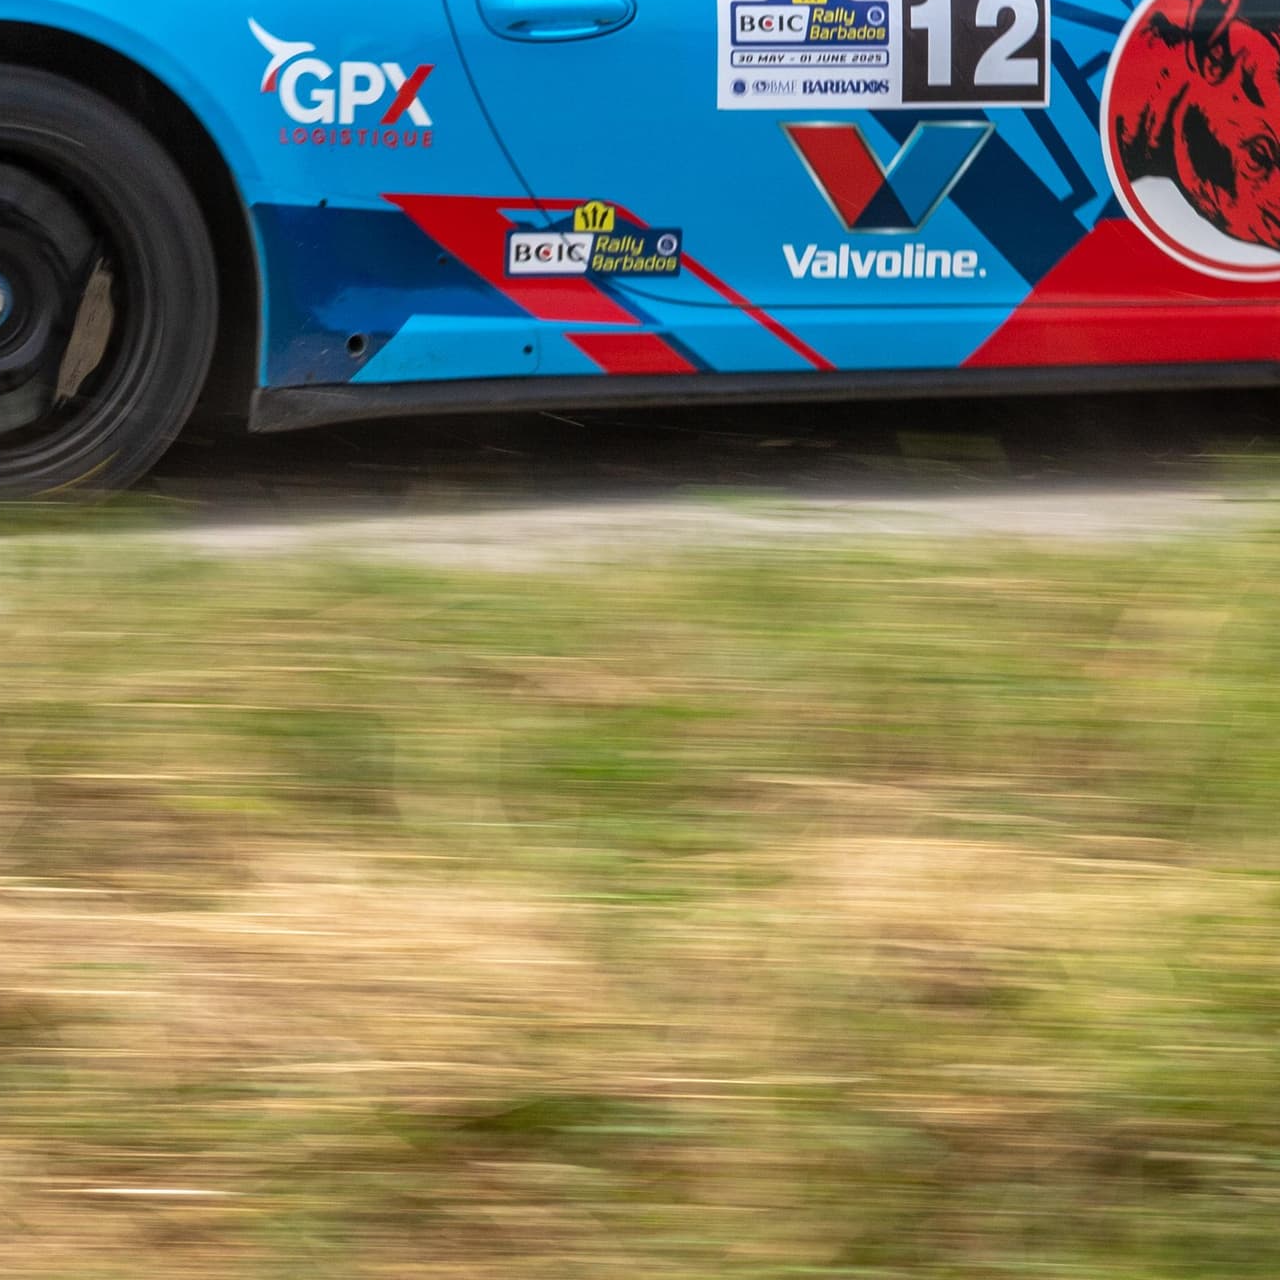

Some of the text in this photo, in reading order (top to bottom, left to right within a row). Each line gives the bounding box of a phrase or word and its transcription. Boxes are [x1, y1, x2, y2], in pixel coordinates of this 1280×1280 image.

[739, 14, 804, 33] BCIC
[812, 6, 856, 26] Rally
[809, 24, 887, 41] Barbados
[738, 54, 754, 64] 30
[758, 54, 785, 64] MAY
[800, 54, 812, 64] 01
[817, 53, 847, 64] JUNE
[852, 54, 882, 63] 2025
[278, 58, 436, 127] GPX
[802, 79, 890, 96] BARBADOS
[279, 127, 434, 149] LOGISTIQUE
[514, 243, 586, 263] BCIC
[595, 235, 645, 256] Rally
[591, 253, 678, 272] Barbados
